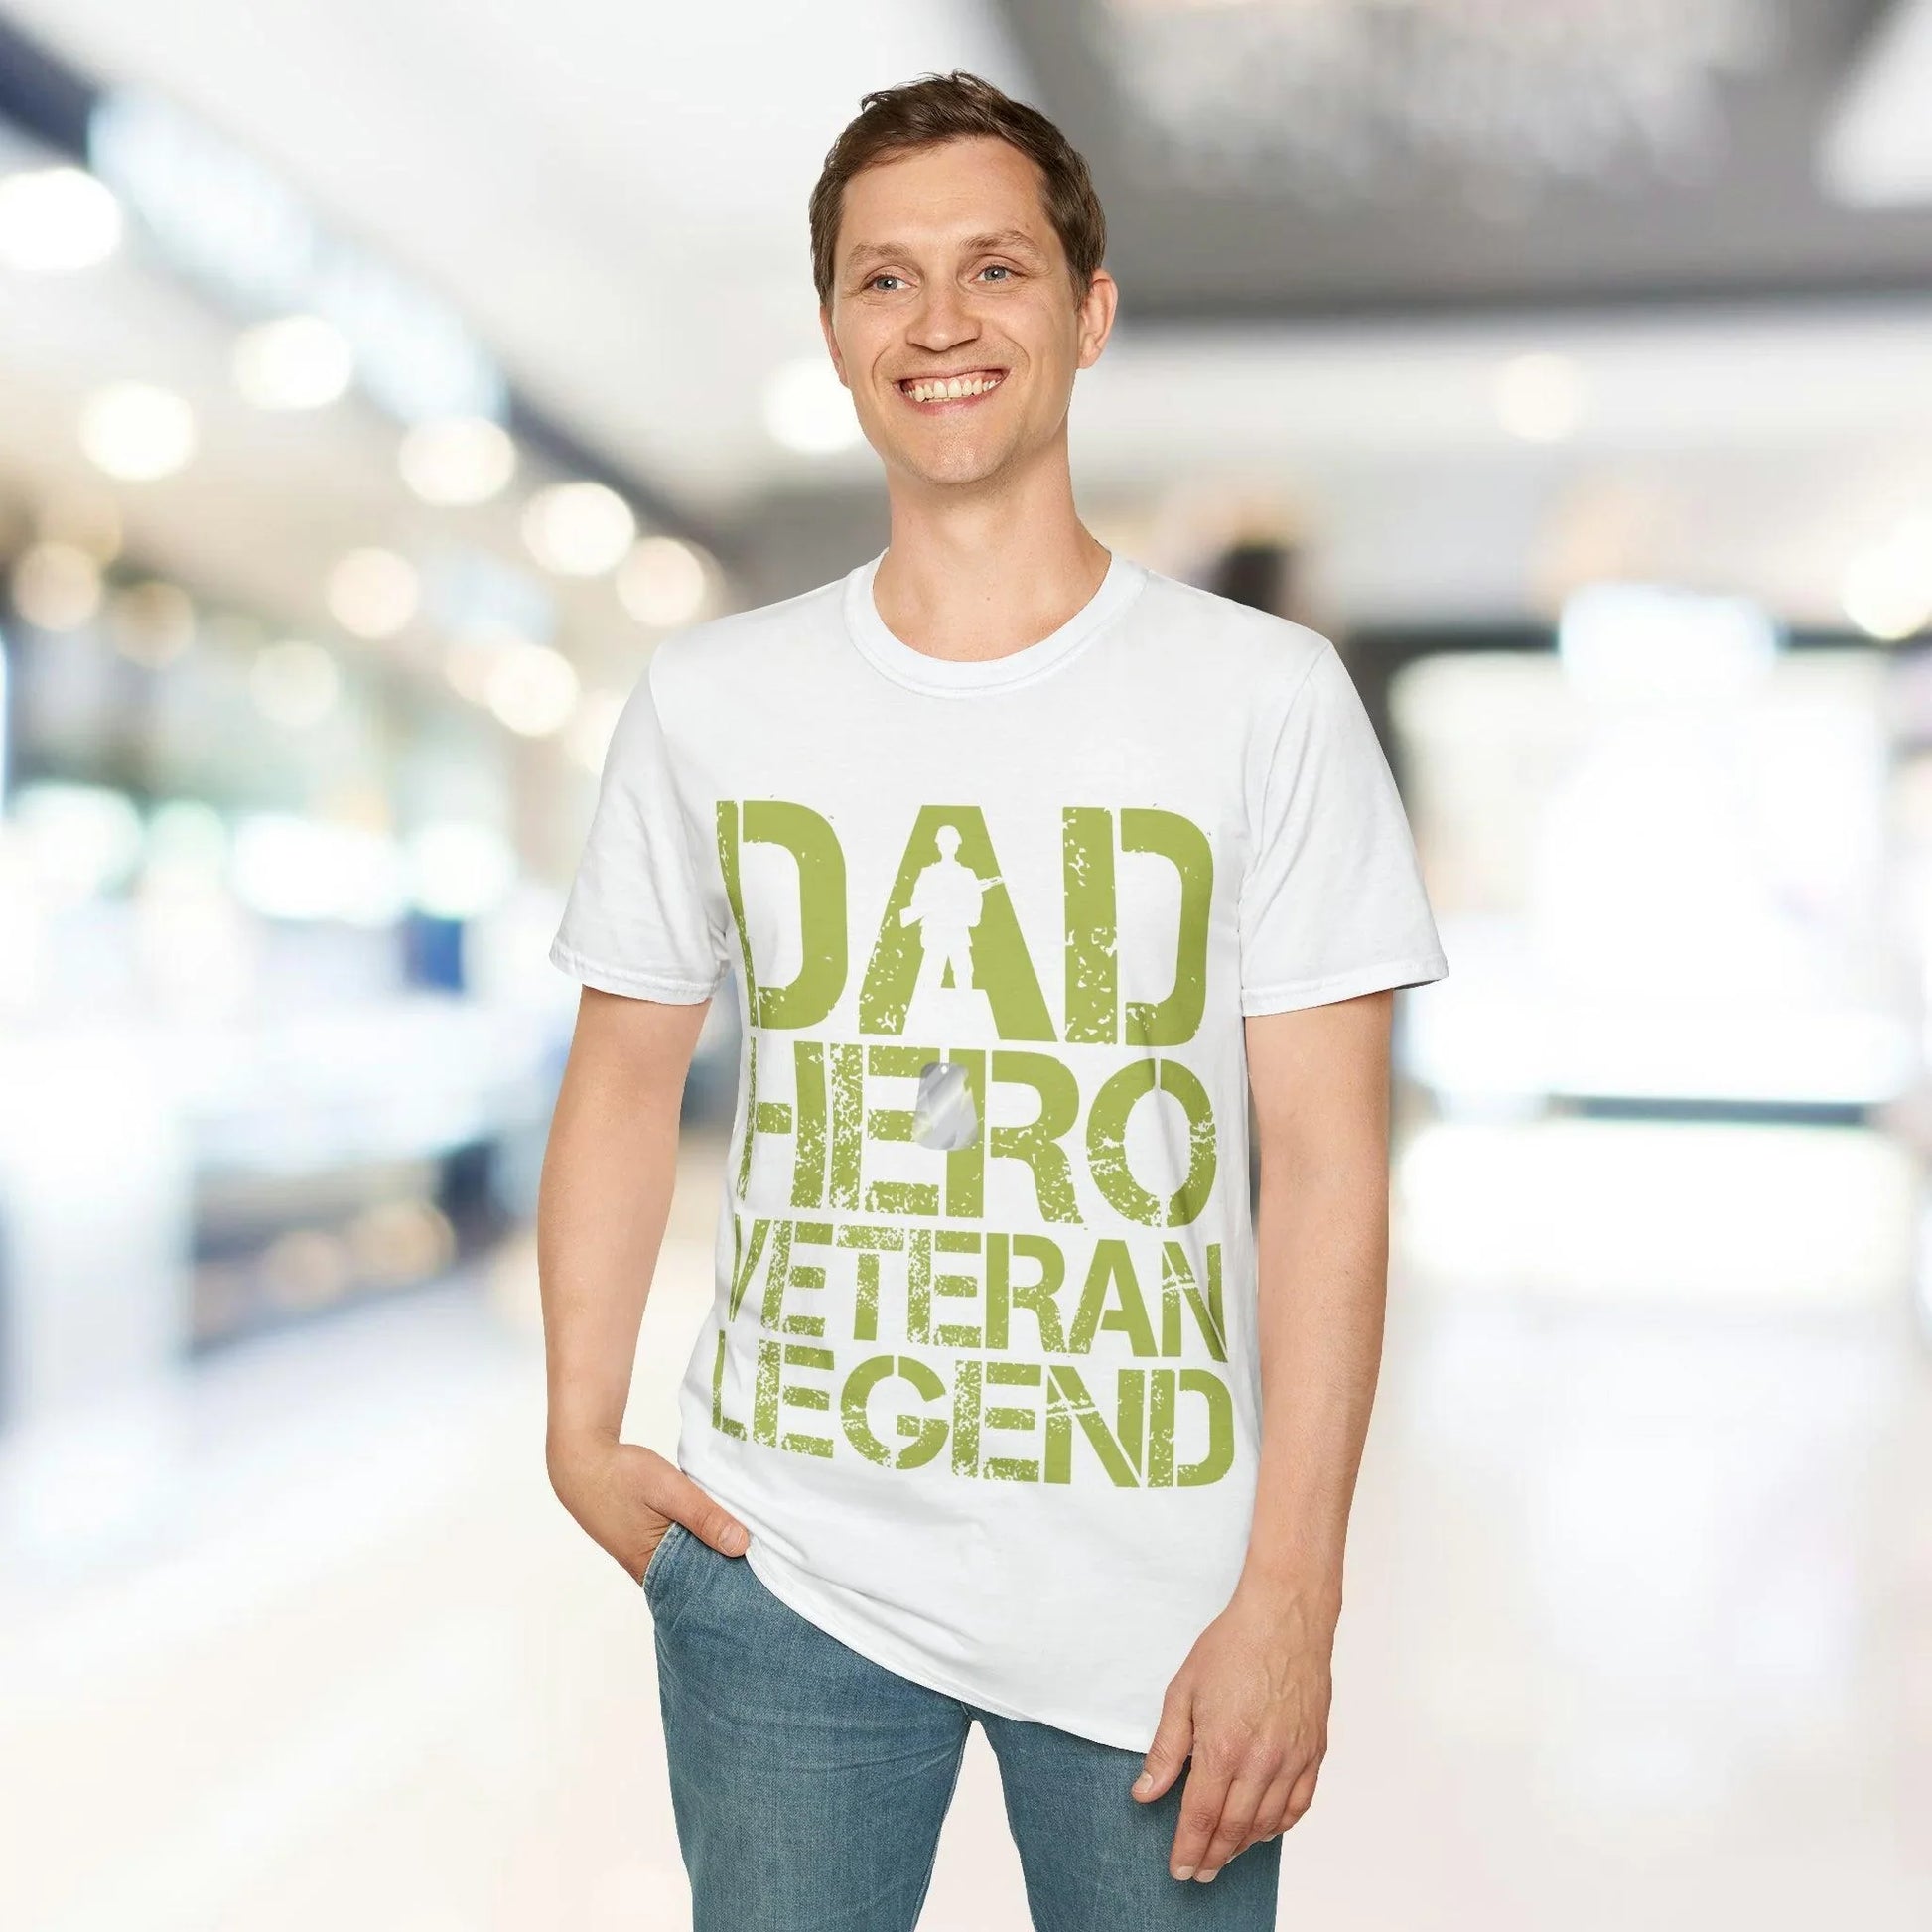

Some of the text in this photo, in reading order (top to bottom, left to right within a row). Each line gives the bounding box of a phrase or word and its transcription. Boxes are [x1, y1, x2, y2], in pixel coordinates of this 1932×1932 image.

[716, 800, 1214, 1046] DAD
[736, 1035, 1217, 1228] HERO
[729, 1213, 1228, 1363] VETERAN
[712, 1329, 1235, 1488] LEGEND
